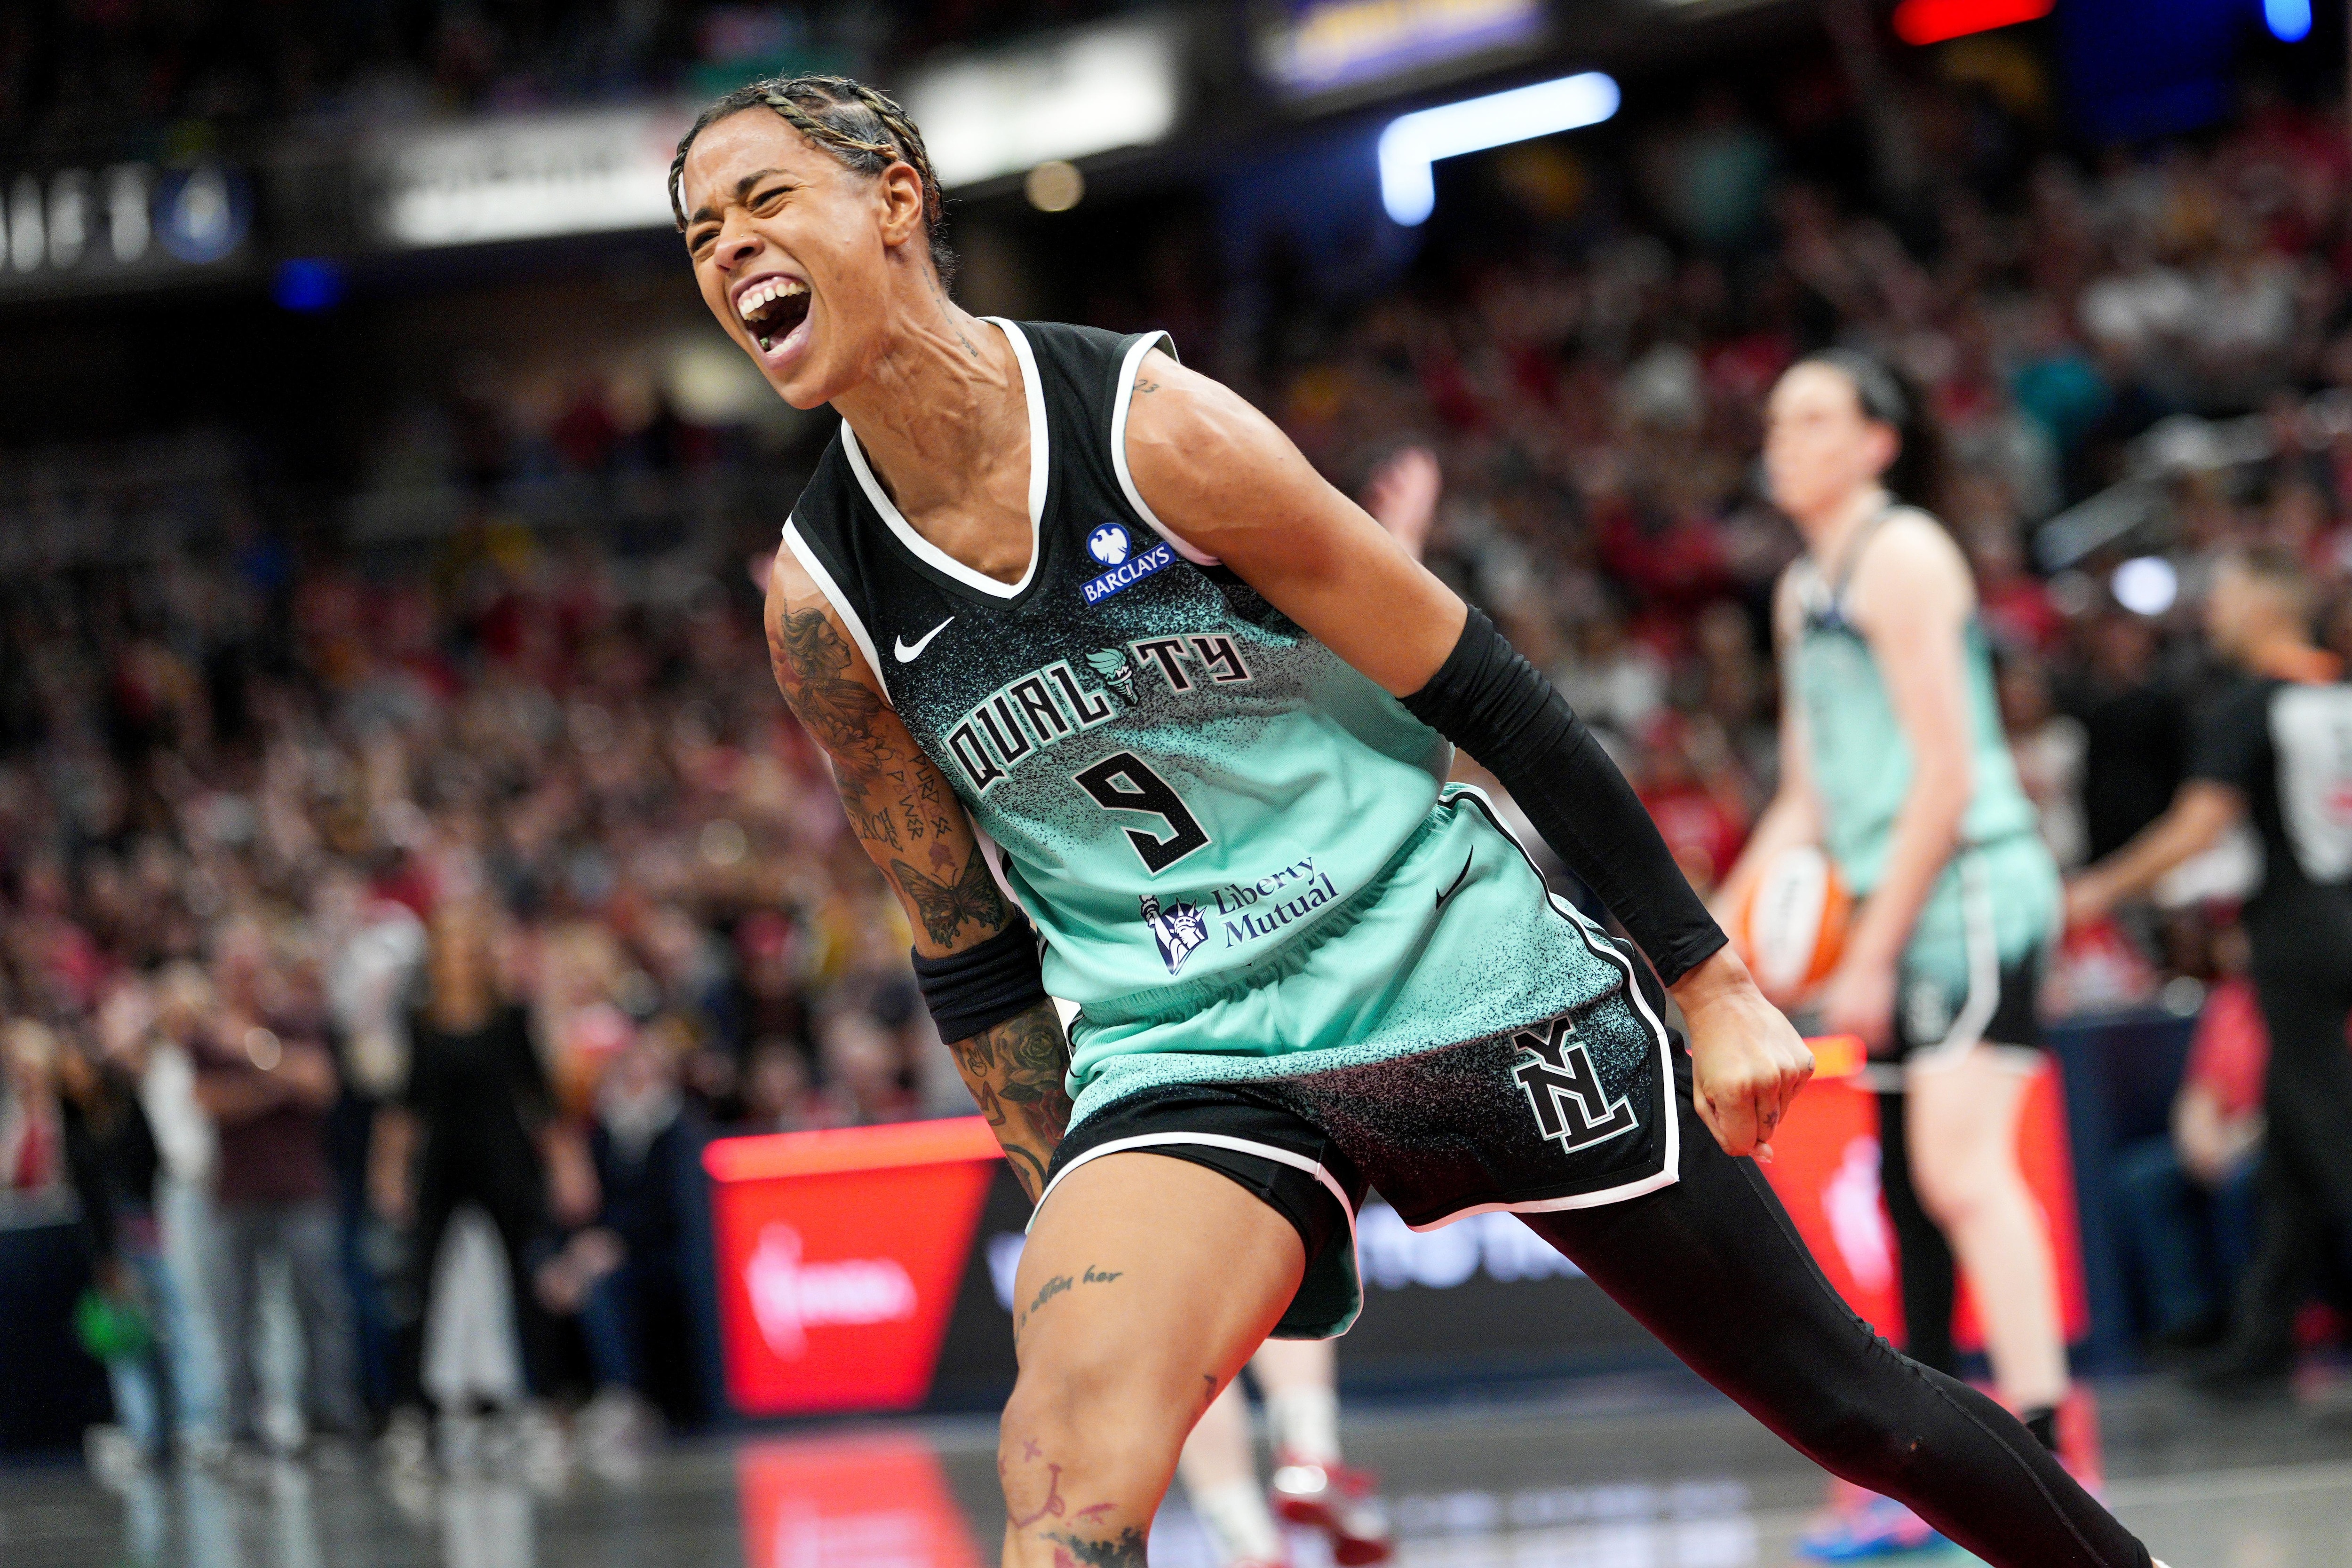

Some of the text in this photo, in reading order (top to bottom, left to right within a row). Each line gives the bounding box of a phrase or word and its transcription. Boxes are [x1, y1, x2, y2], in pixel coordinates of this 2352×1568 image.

[1084, 546, 1170, 602] BARCLAYS
[1070, 751, 1213, 879] 9
[1210, 856, 1316, 917] Liberty
[1222, 872, 1341, 949] Mutual
